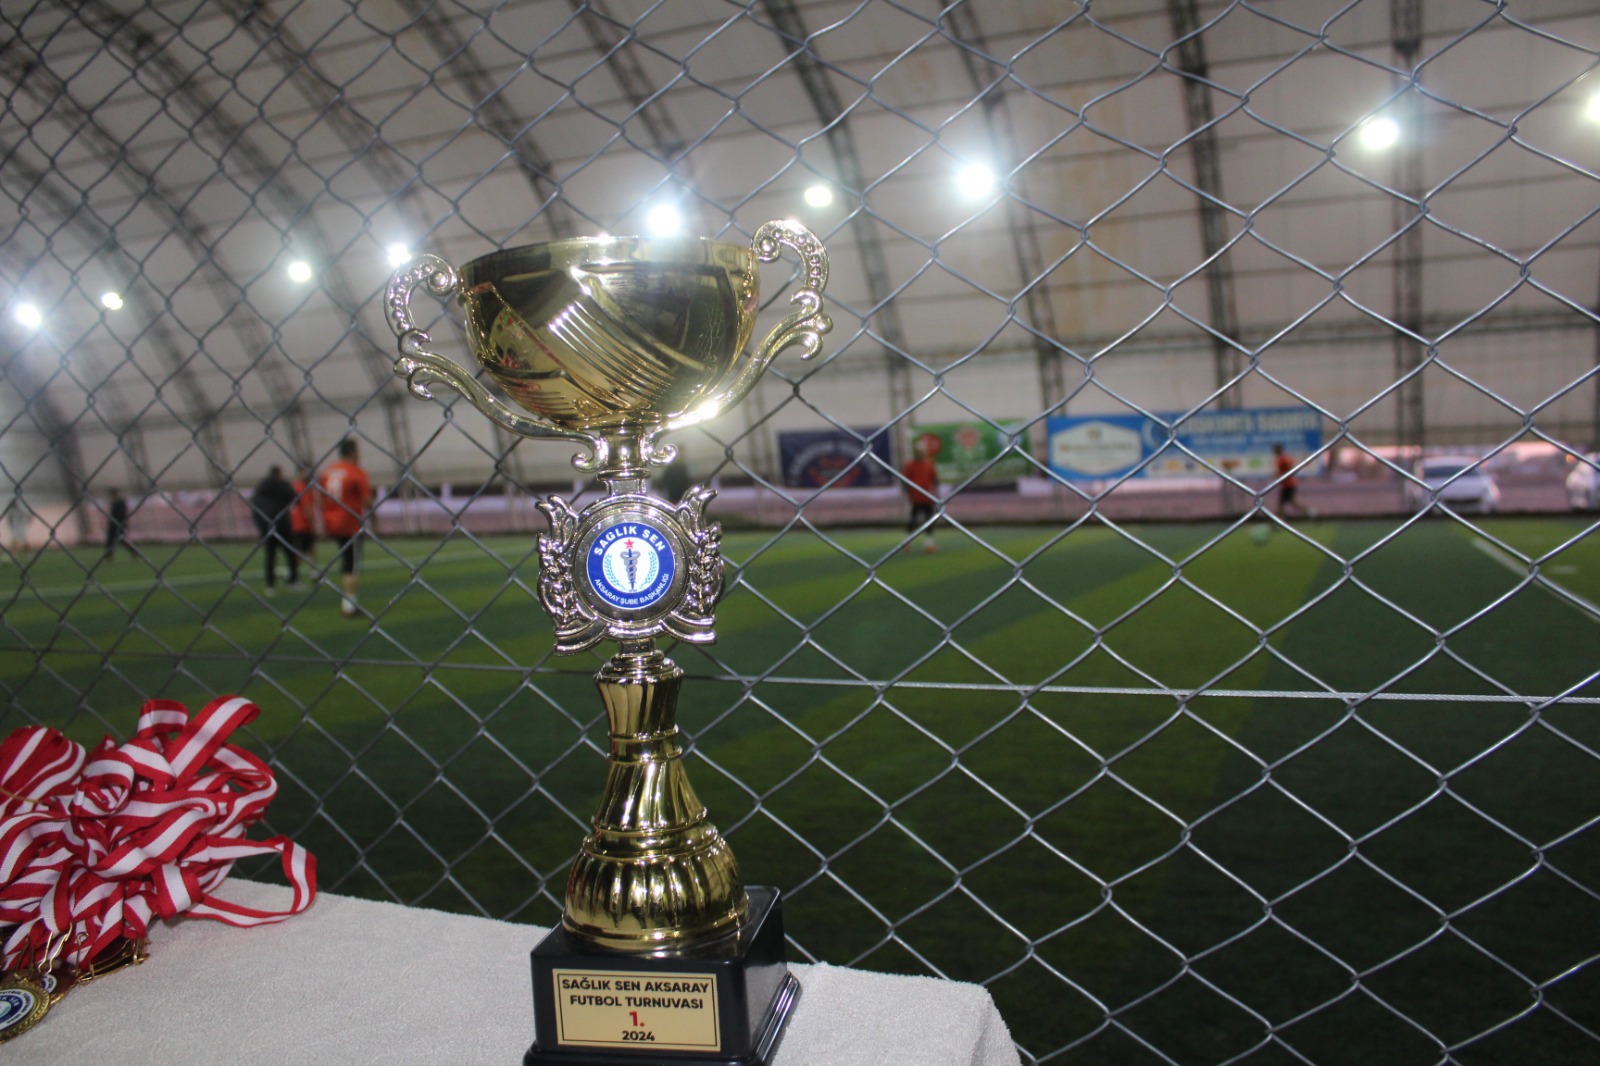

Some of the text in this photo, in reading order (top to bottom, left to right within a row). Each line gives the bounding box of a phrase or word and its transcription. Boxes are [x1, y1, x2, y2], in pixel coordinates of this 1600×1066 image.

[641, 529, 665, 551] SEN
[594, 578, 620, 602] AKSARAY
[562, 977, 709, 993] SAĞLIK SEN AKSARAY
[569, 995, 704, 1009] FUTBOL TURNUVASI
[629, 1011, 645, 1027] 1.
[622, 1030, 656, 1042] 2024
